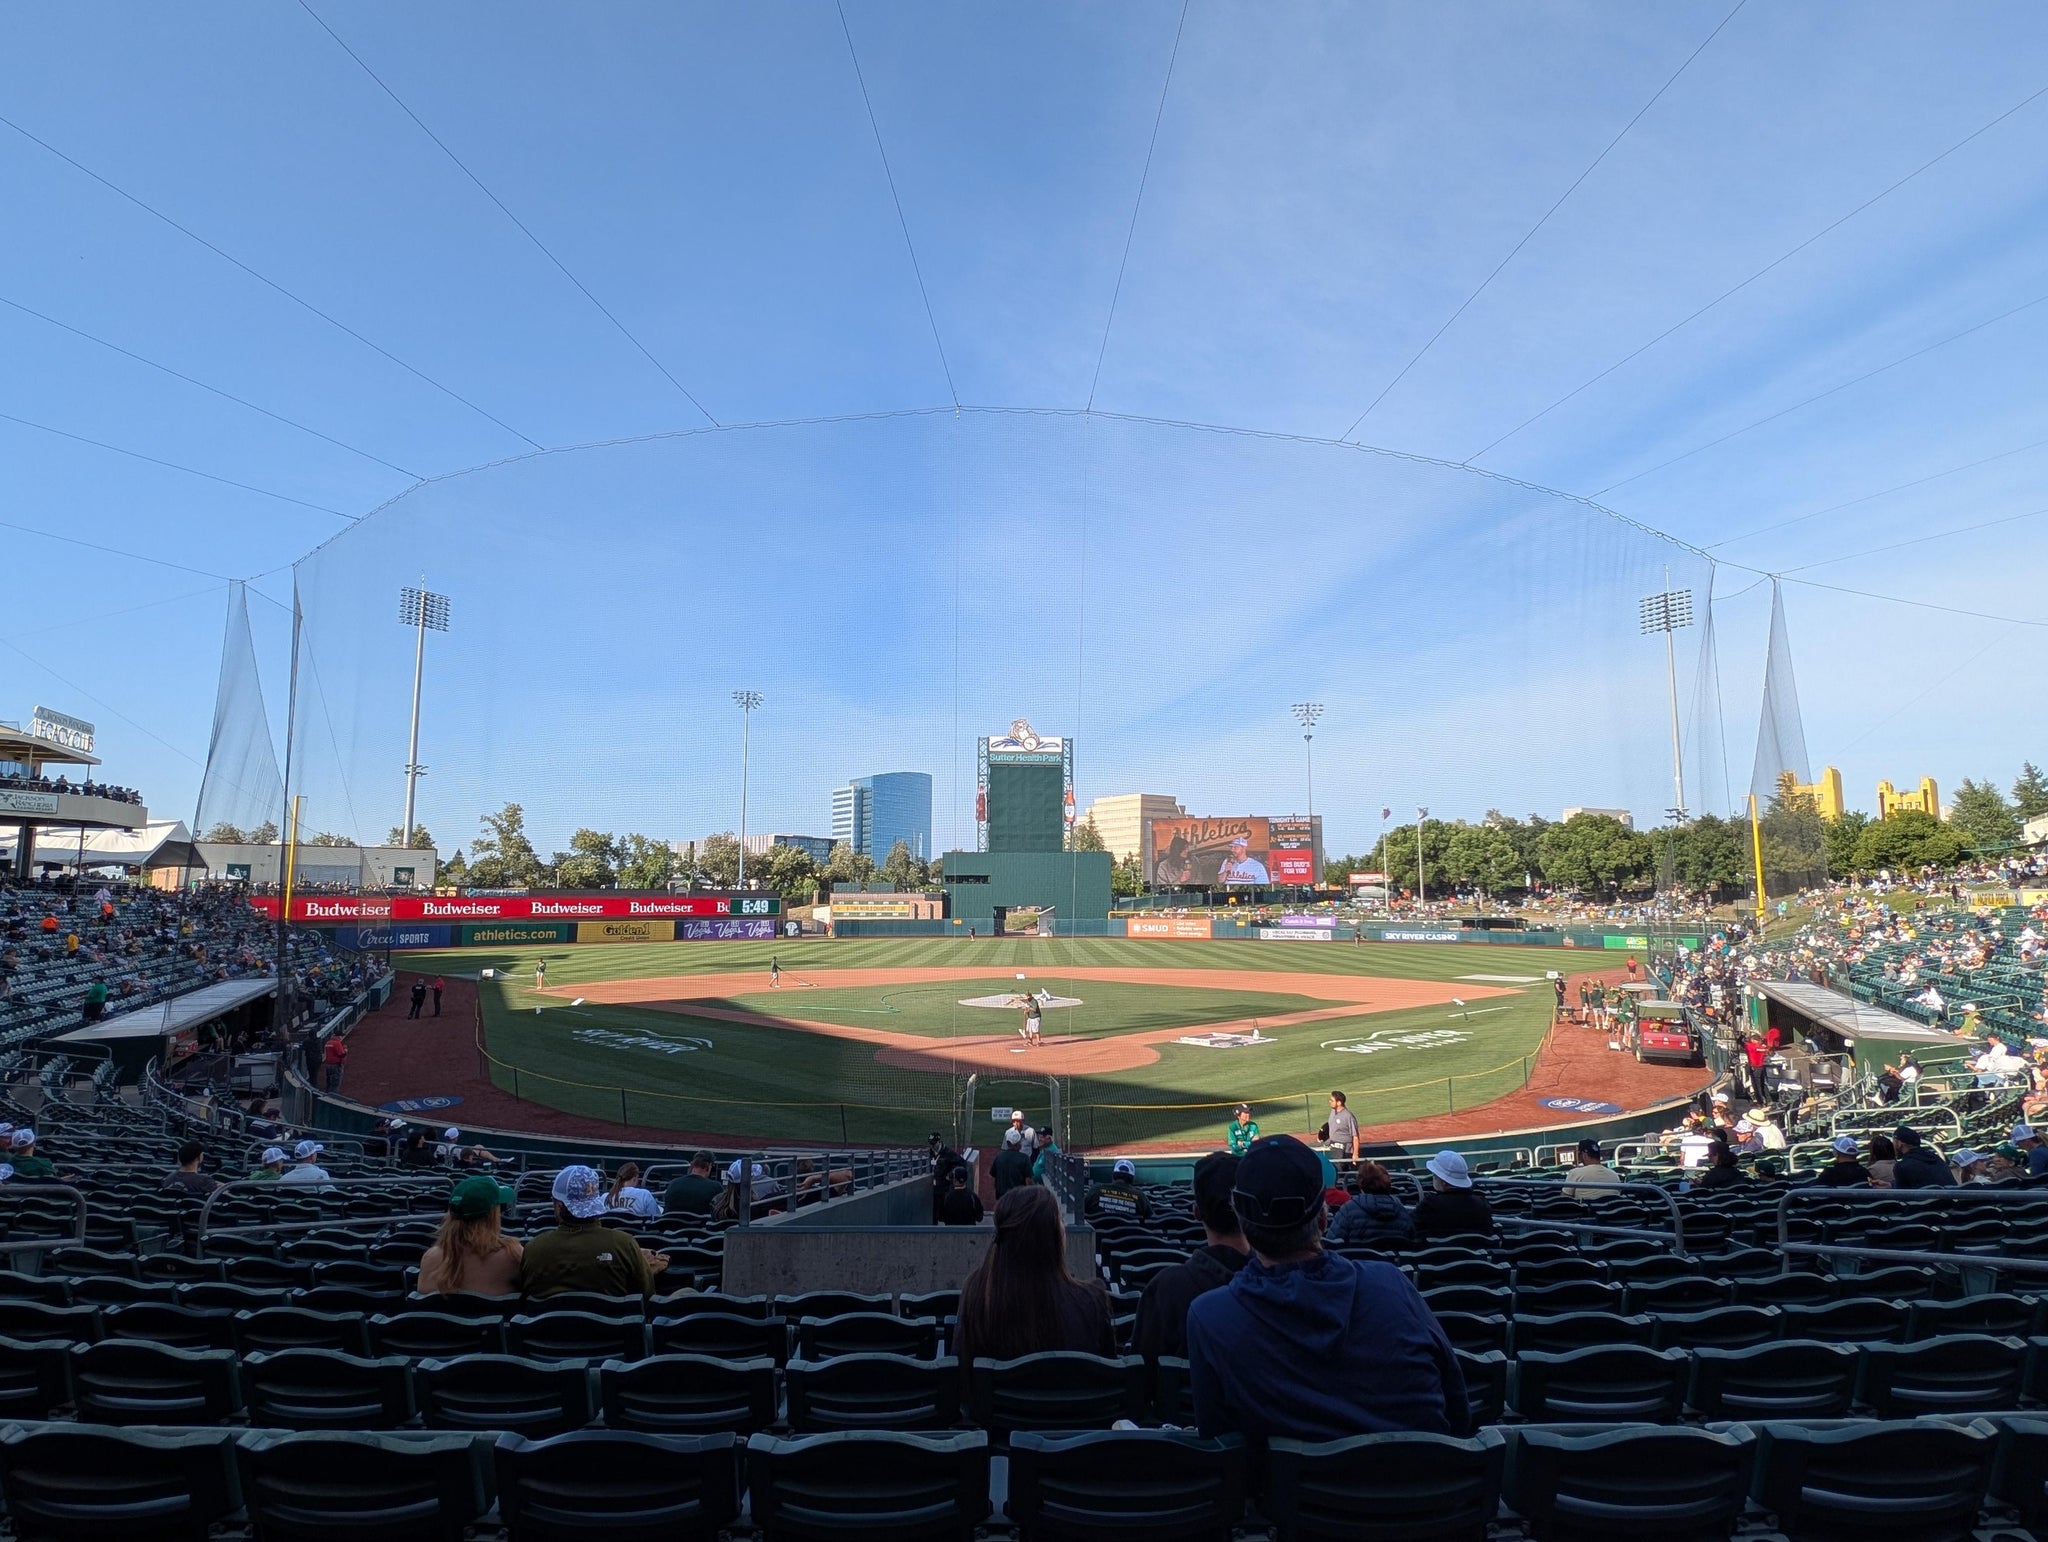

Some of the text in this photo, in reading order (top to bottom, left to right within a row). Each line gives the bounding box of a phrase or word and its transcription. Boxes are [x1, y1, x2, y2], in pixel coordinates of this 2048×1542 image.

[36, 718, 95, 754] LEGACY CLUB
[990, 753, 1062, 762] Sutter Health Park
[305, 903, 391, 917] Budweiser
[422, 902, 500, 915] Budweiser
[531, 902, 602, 914] Budweiser
[629, 902, 693, 913] Budweiser
[741, 900, 769, 913] 5:49
[684, 922, 713, 939] Vegas
[715, 922, 744, 938] Vegas
[745, 922, 774, 938] Vegas
[1142, 924, 1169, 932] SMUD
[357, 928, 395, 949] Circa
[399, 933, 430, 944] SPORTS
[473, 929, 557, 941] athletics.com
[1385, 932, 1400, 940] SKY
[1425, 933, 1457, 941] CASINO
